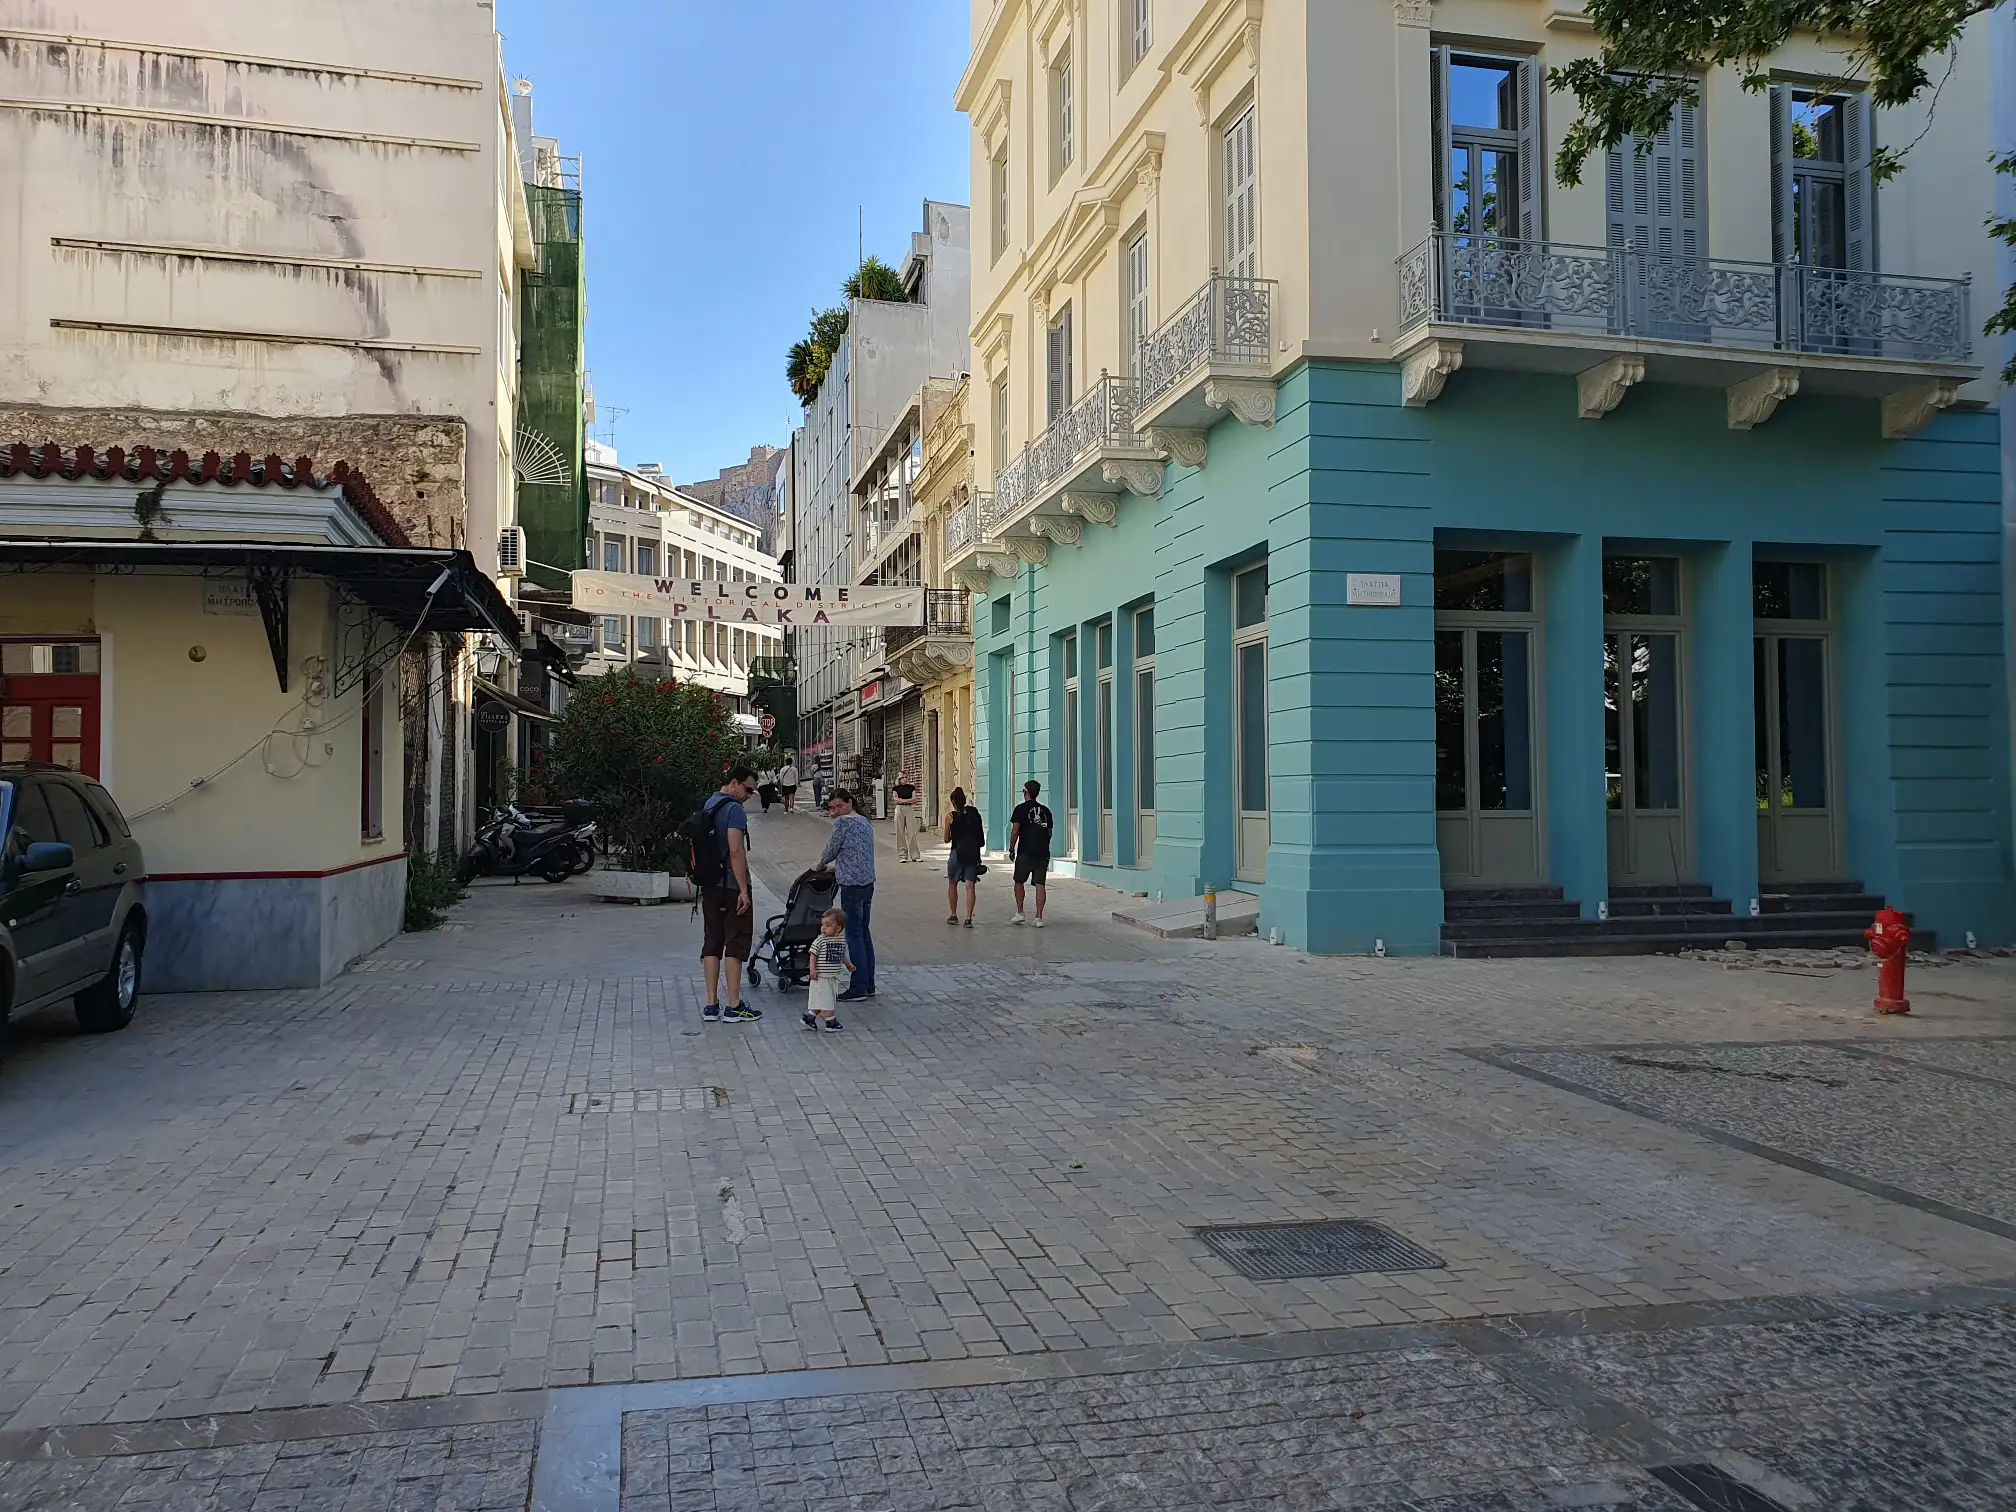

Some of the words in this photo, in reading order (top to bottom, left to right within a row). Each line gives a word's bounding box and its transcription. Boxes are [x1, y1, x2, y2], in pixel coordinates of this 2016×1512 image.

[584, 587, 605, 596] TO
[621, 590, 653, 600] THE
[668, 595, 781, 608] HISTORICAL
[796, 602, 880, 610] DISTRICT
[654, 578, 849, 602] WELCOME
[673, 603, 830, 624] PLAKA
[761, 718, 774, 727] STOP
